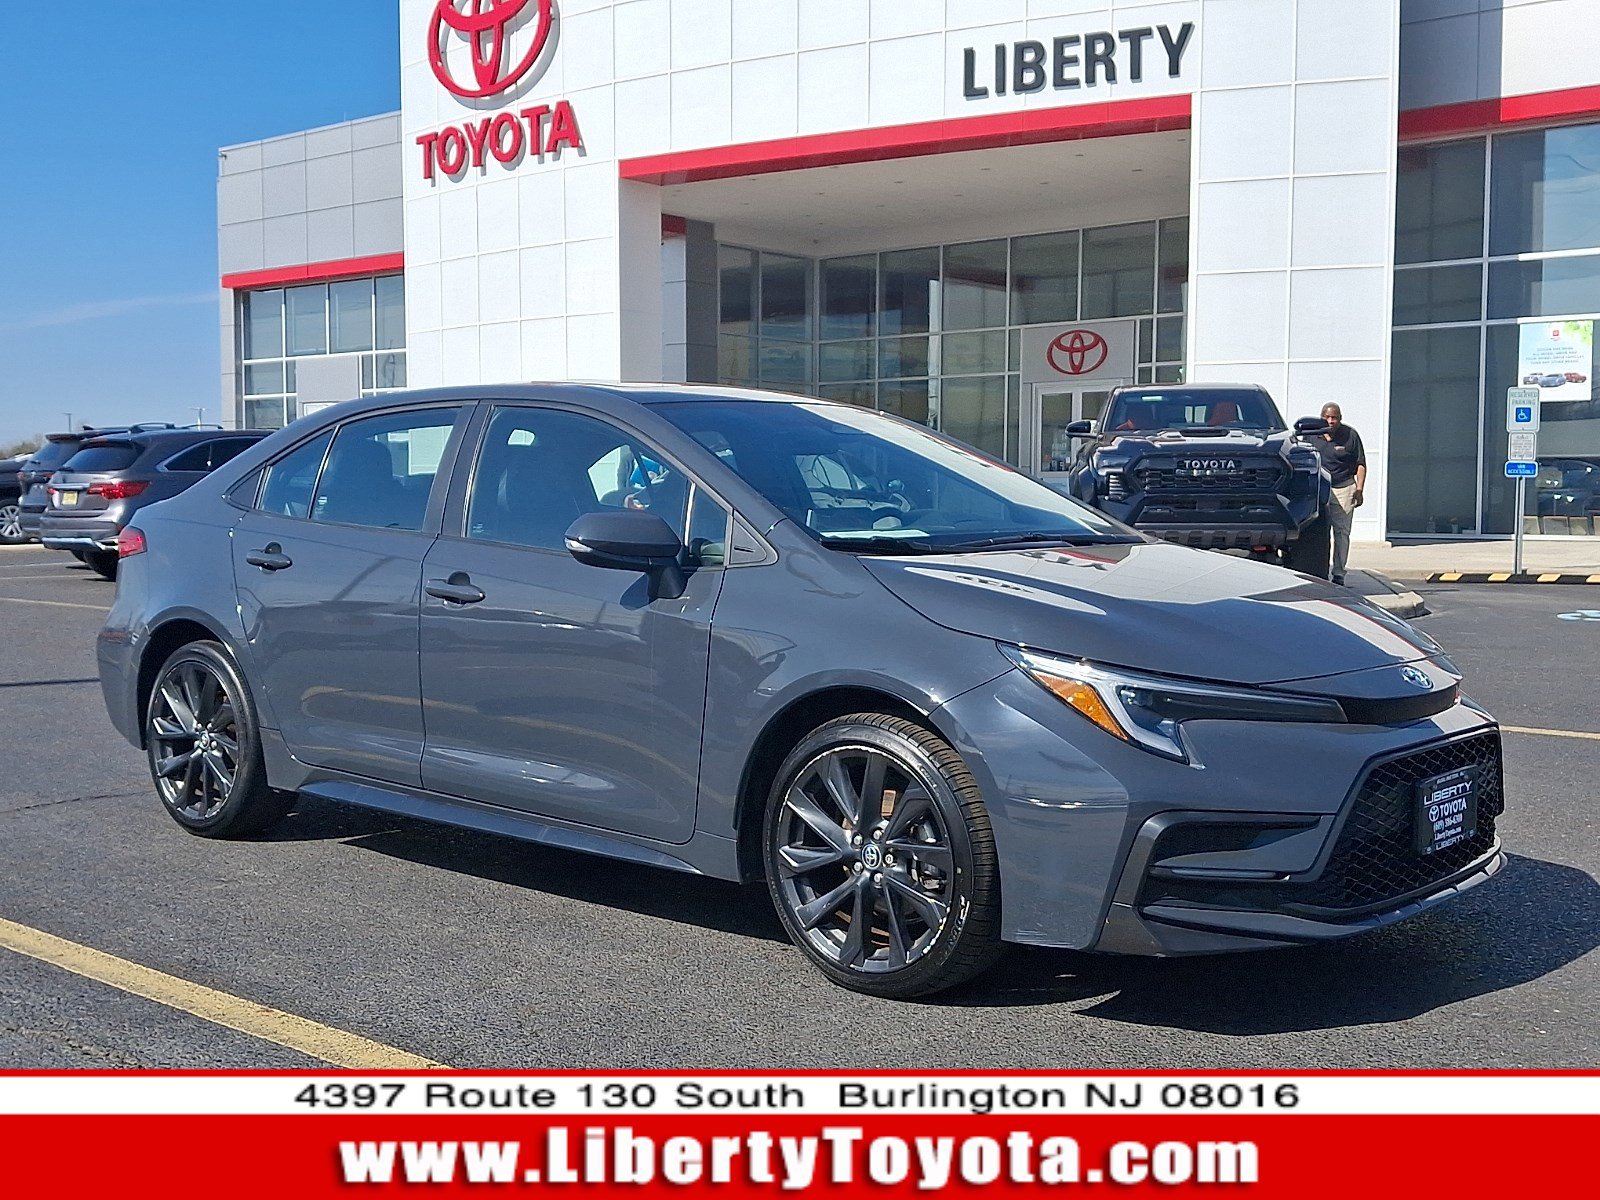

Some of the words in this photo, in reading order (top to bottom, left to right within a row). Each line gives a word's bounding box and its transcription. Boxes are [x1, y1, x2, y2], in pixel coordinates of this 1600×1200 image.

[964, 21, 1194, 99] LIBERTY
[416, 100, 581, 180] TOYOTA
[1183, 460, 1235, 469] TOYOTA
[1423, 780, 1473, 805] LIBERTY
[1440, 797, 1467, 818] TOYOTA
[1436, 834, 1465, 850] LIBERTY
